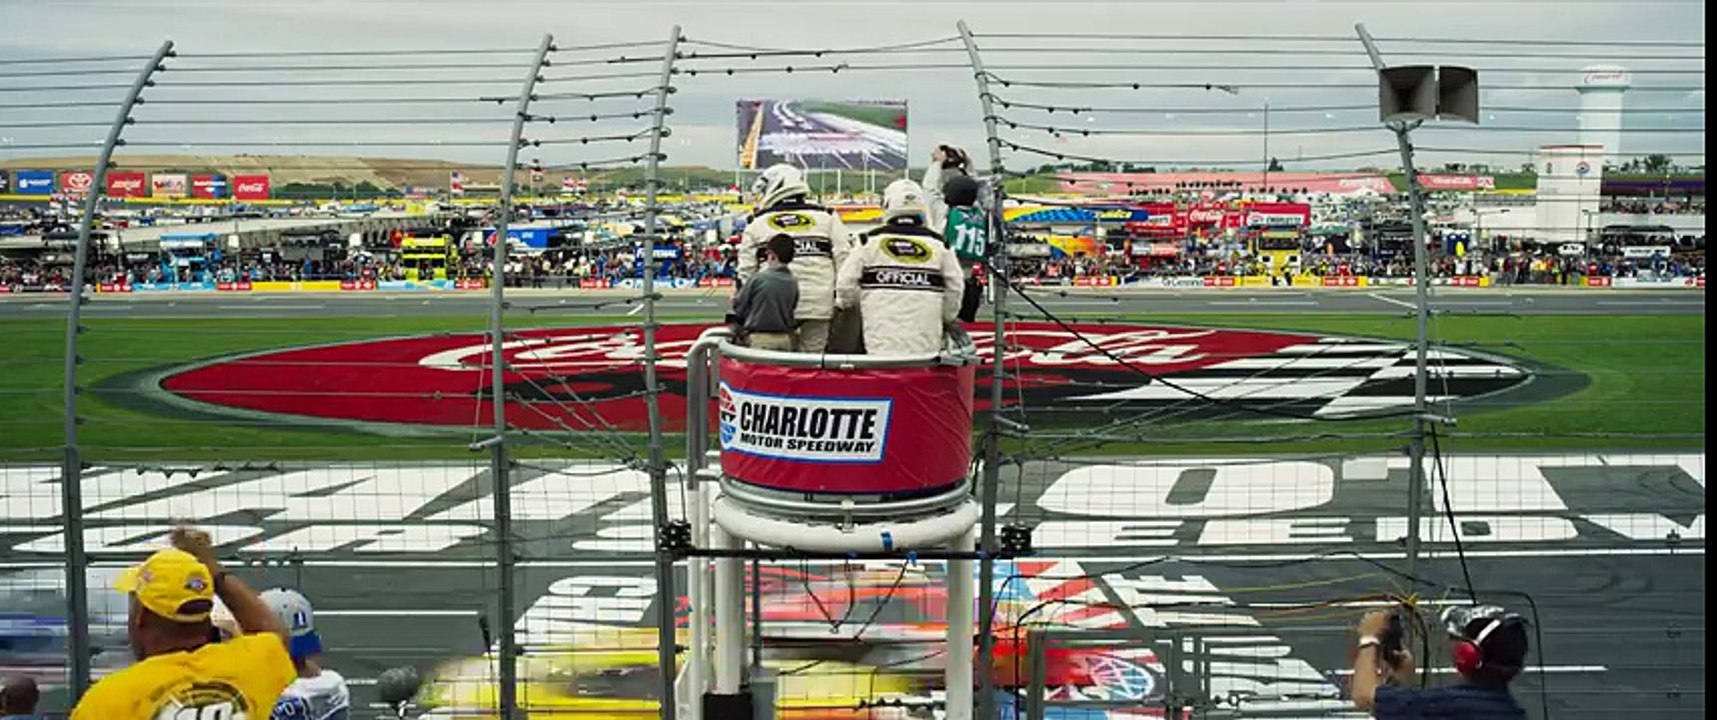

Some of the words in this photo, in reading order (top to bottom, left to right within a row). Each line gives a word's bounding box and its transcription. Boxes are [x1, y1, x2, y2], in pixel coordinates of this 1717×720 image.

[954, 223, 985, 257] 115
[876, 271, 931, 285] OFFICIAL
[740, 401, 878, 440] CHARLOTTE
[741, 433, 783, 448] MOTOR
[787, 438, 875, 454] SPEEDWAY
